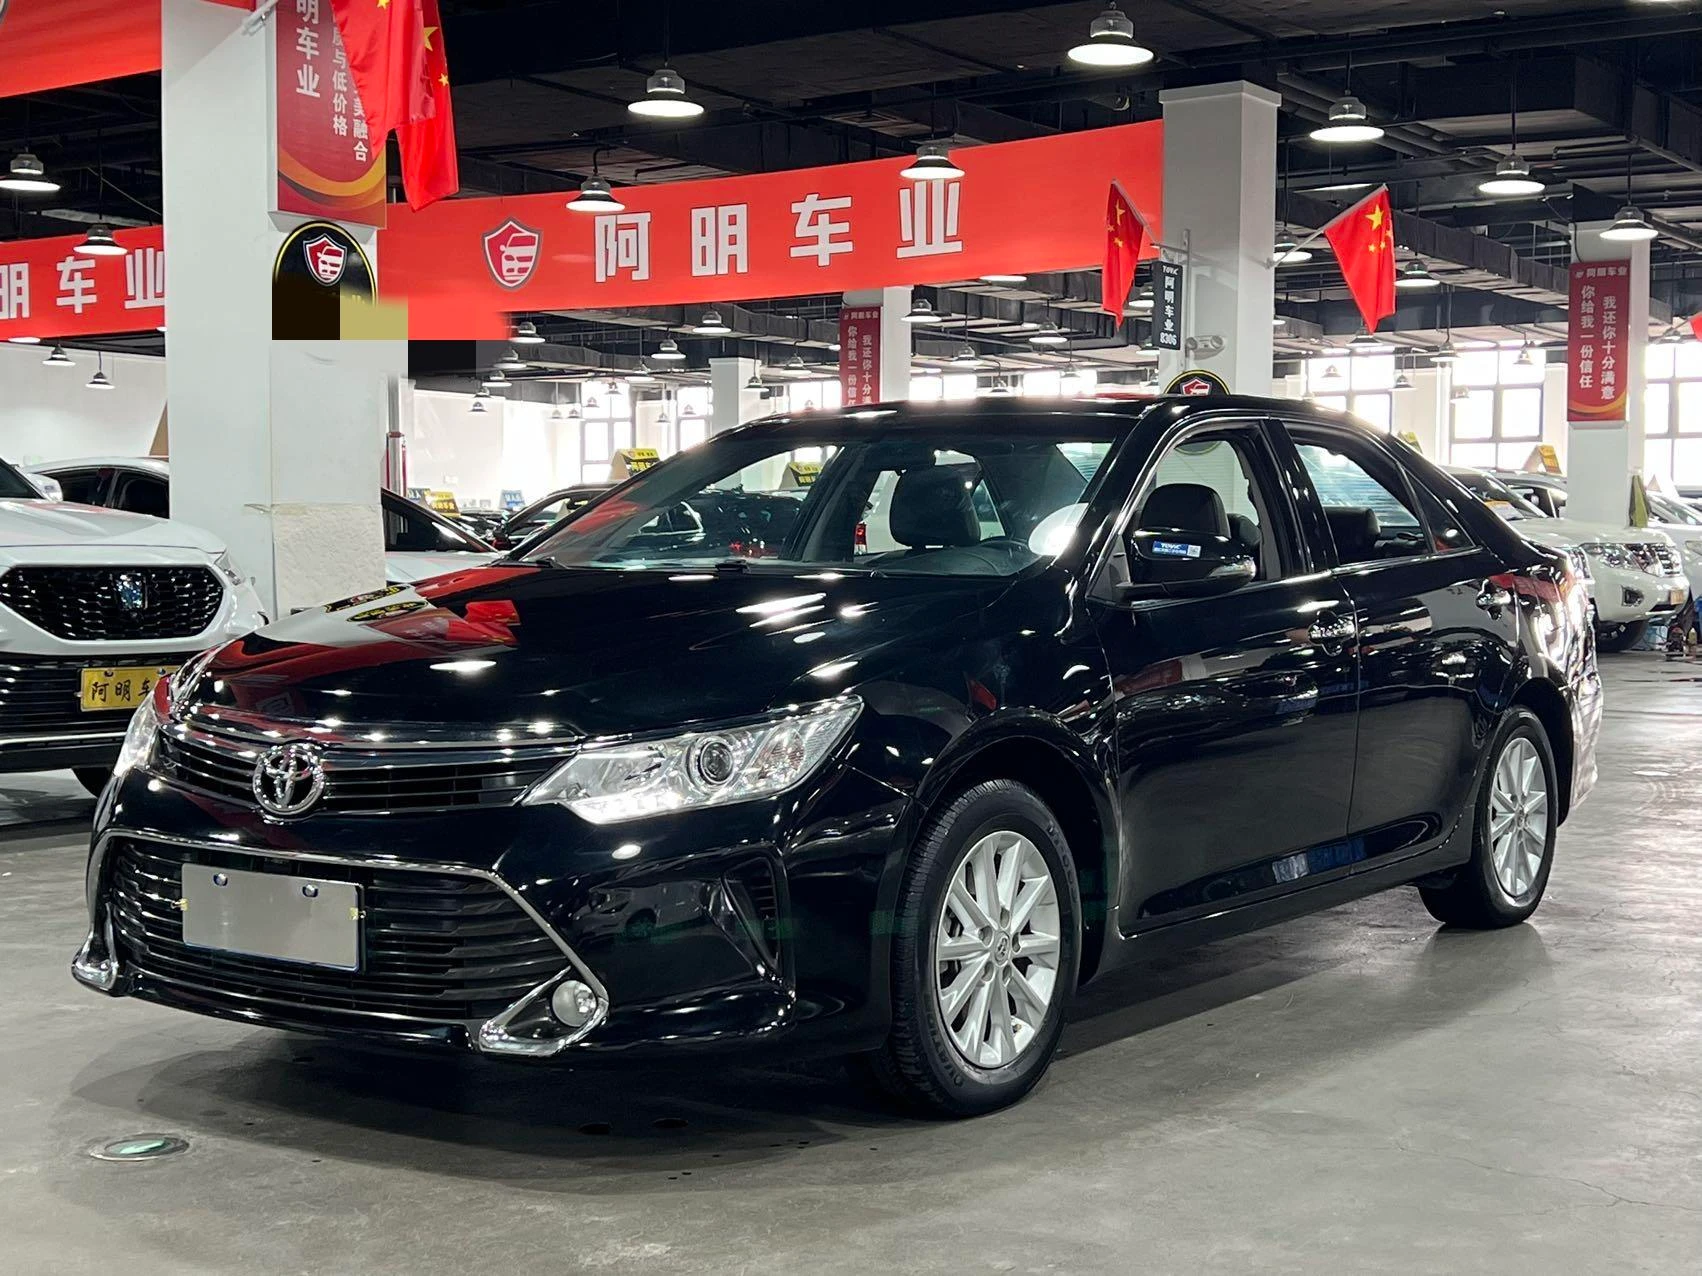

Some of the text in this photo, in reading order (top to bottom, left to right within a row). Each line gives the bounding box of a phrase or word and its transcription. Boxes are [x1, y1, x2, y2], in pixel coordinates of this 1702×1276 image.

[353, 89, 368, 162] 美融合
[594, 178, 964, 283] 阿明车业
[1586, 267, 1628, 278] 阿明车业
[1164, 276, 1175, 332] 阿明车业
[1579, 285, 1595, 389] 你给我一份信任
[1601, 296, 1616, 400] 我还你十分满意
